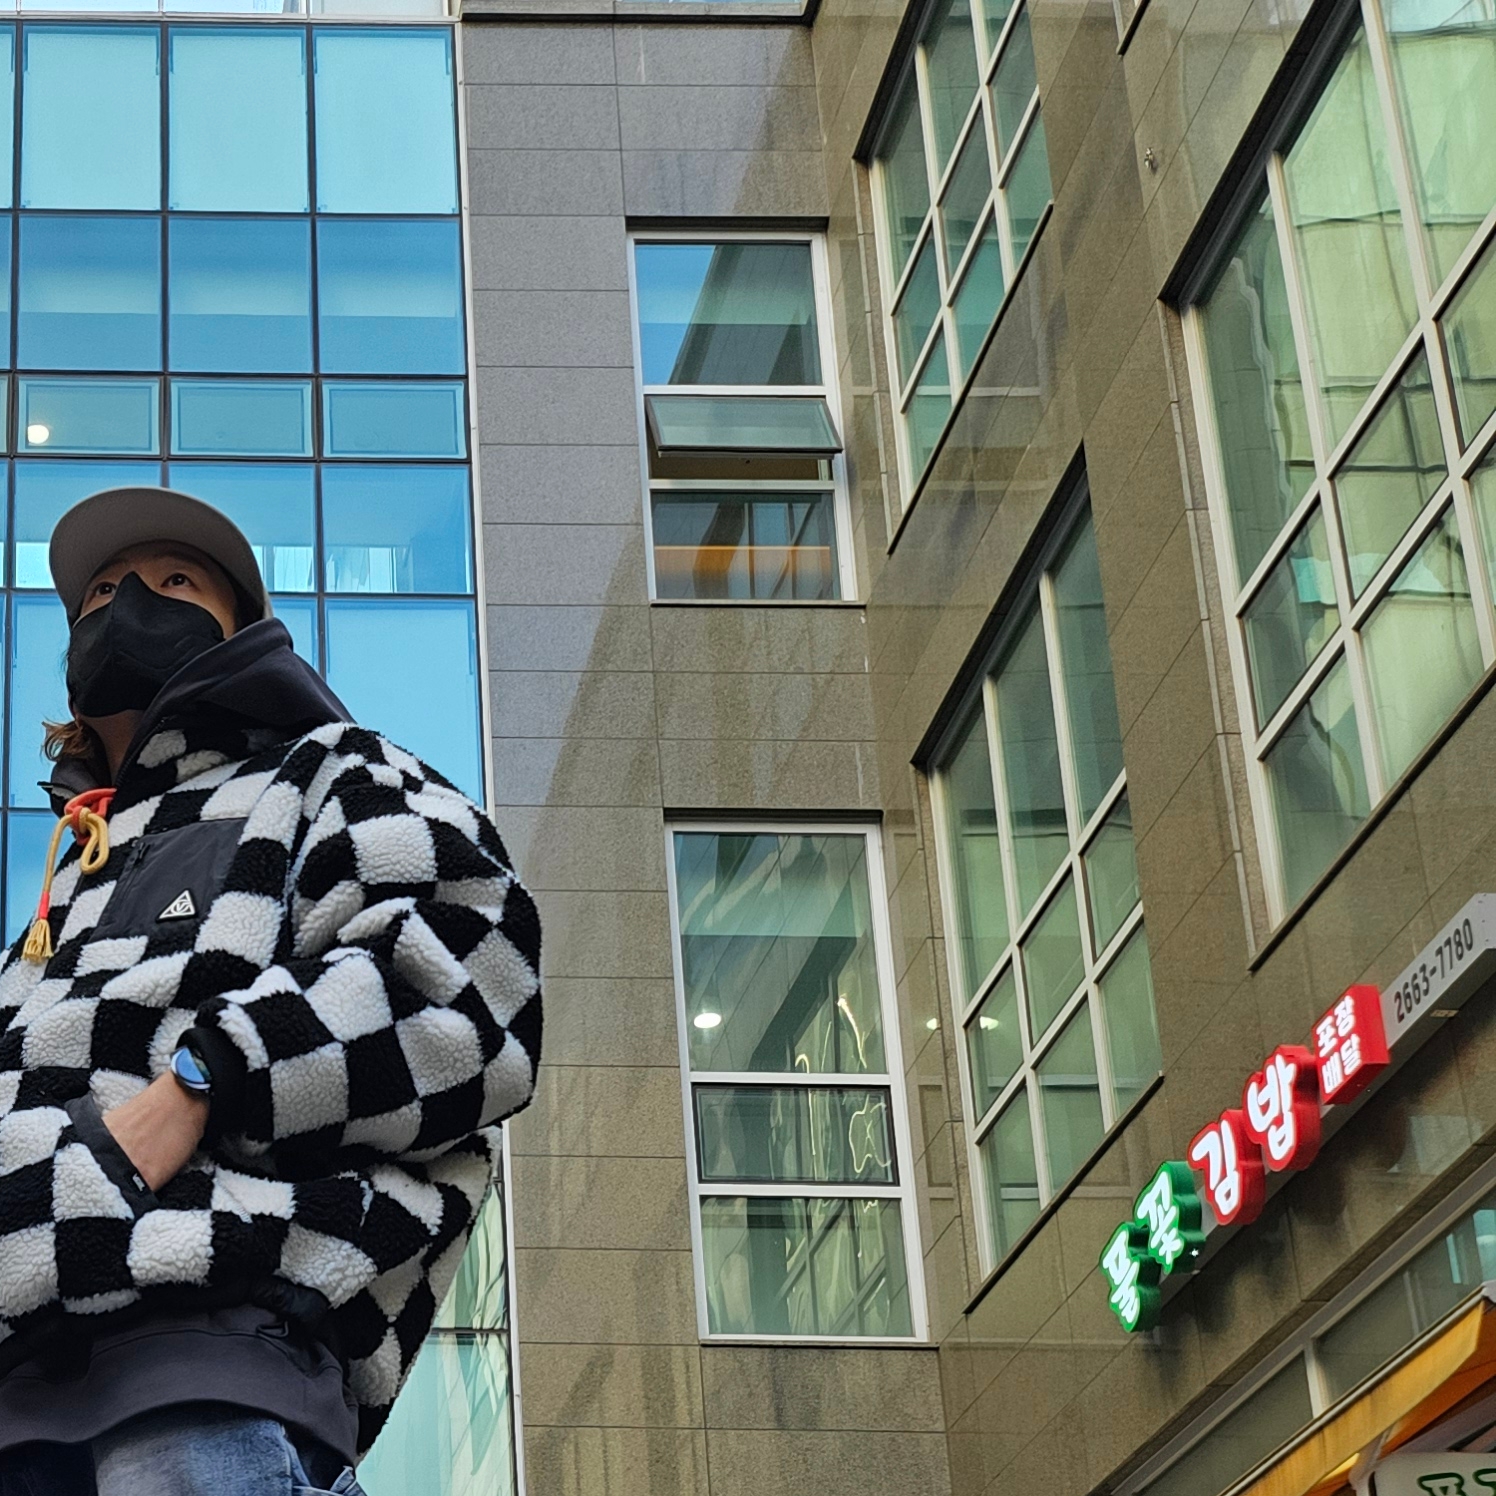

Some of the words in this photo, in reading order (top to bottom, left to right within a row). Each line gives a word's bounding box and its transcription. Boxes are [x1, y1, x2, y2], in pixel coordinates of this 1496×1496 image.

[1394, 918, 1474, 1024] 2663-7780
[1316, 995, 1355, 1058] 포장
[1321, 1033, 1363, 1094] 배달
